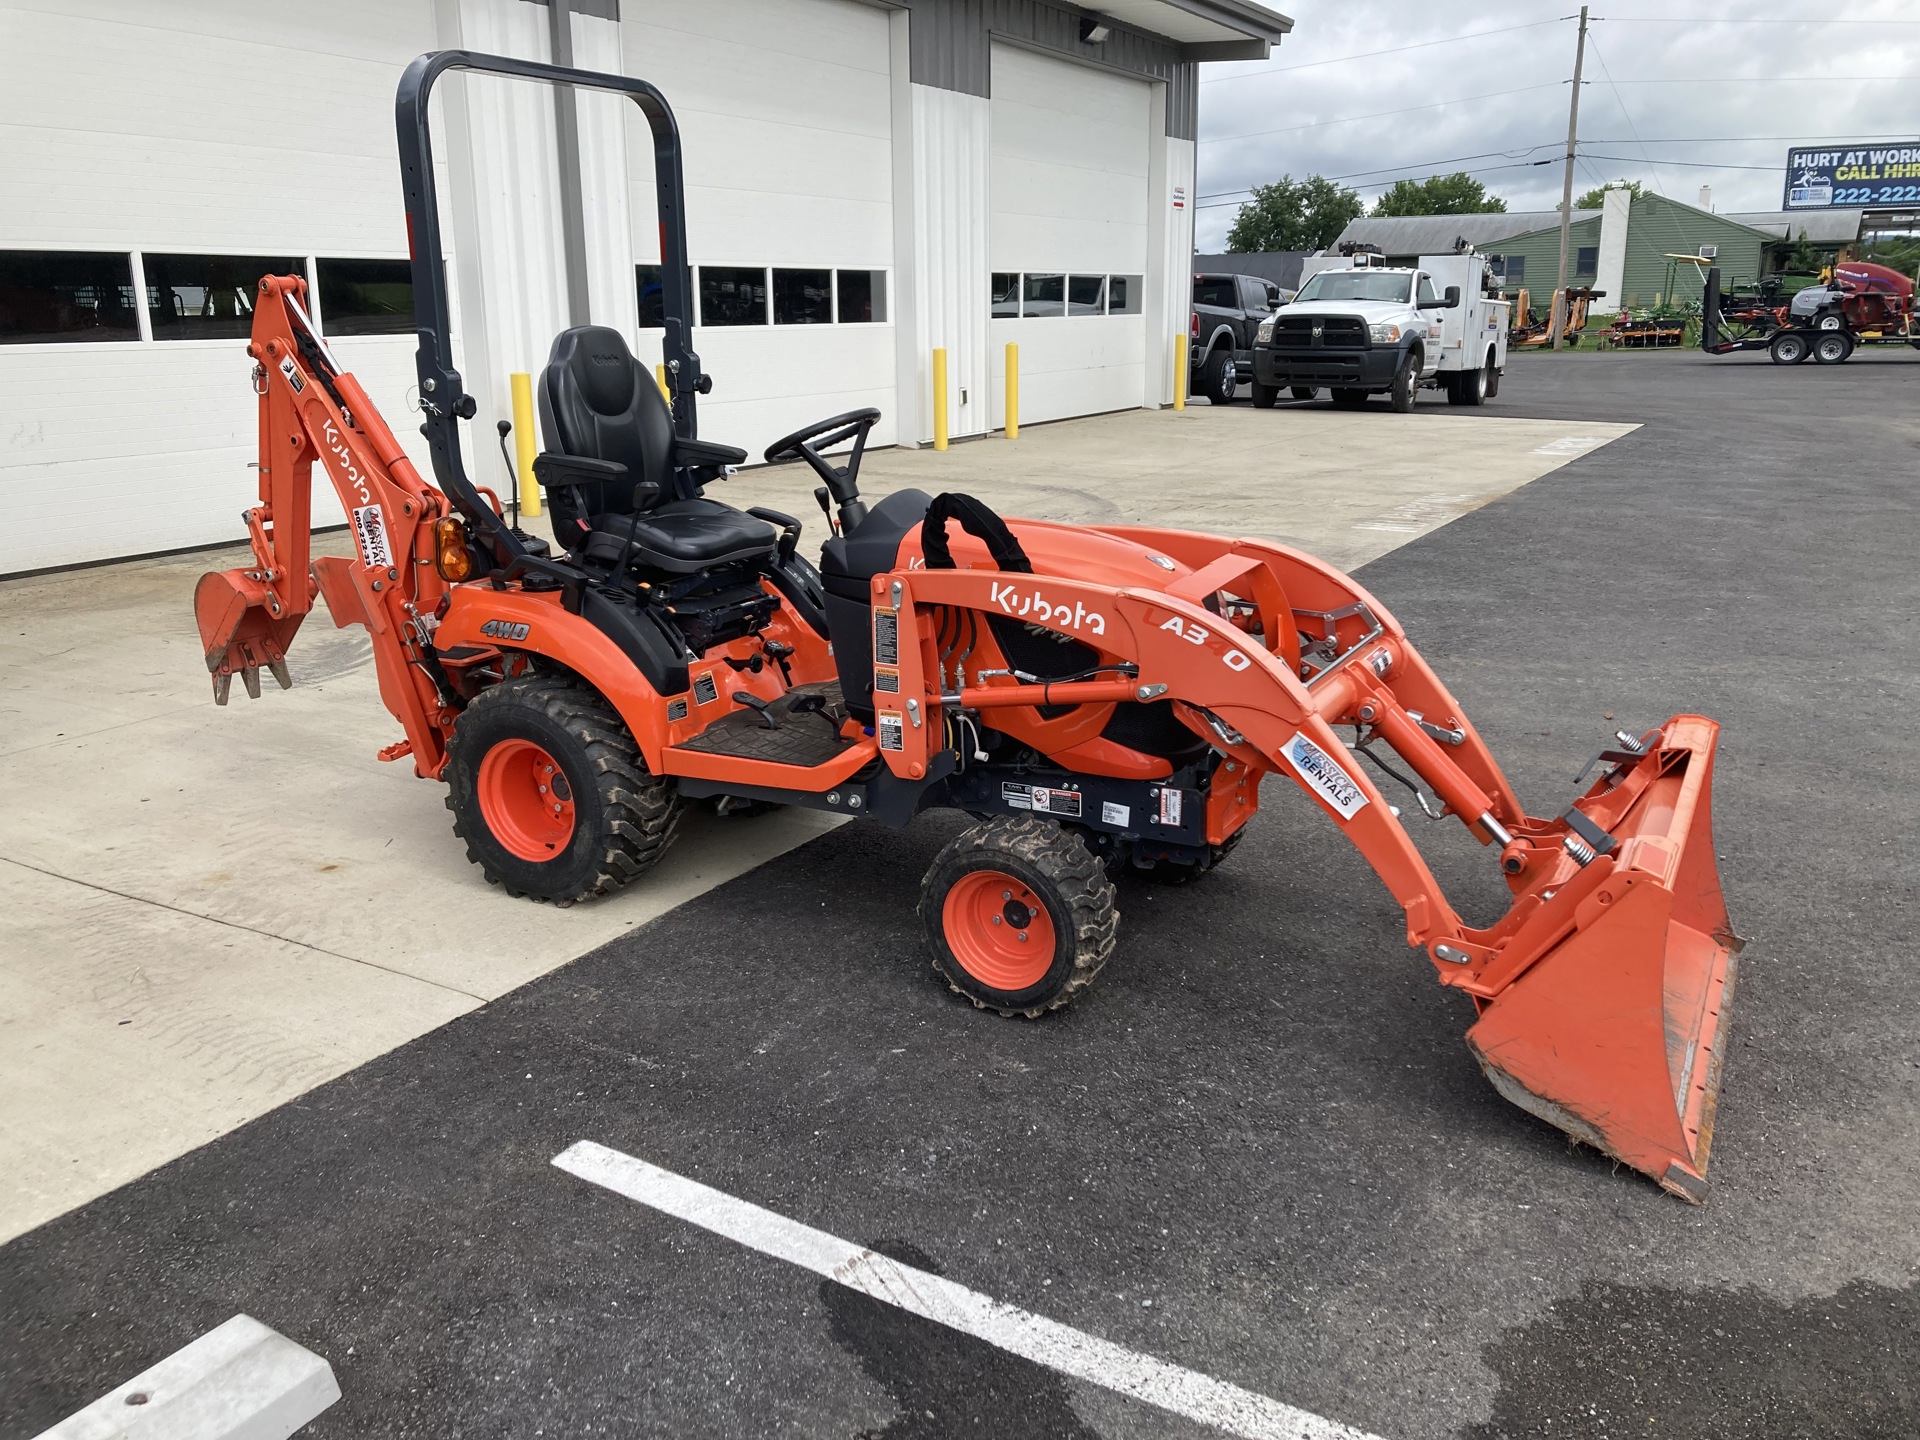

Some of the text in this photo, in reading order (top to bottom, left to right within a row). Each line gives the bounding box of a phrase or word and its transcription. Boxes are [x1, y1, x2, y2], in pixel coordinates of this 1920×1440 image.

[1793, 148, 1920, 168] HURT AT WORK
[1835, 163, 1920, 181] CALL HHR
[322, 418, 371, 504] Kubota
[354, 510, 372, 566] 800-222-33
[366, 521, 380, 565] RENTAL
[480, 619, 531, 641] 4WD
[990, 581, 1106, 636] Kubota
[1300, 755, 1352, 807] RENTALS
